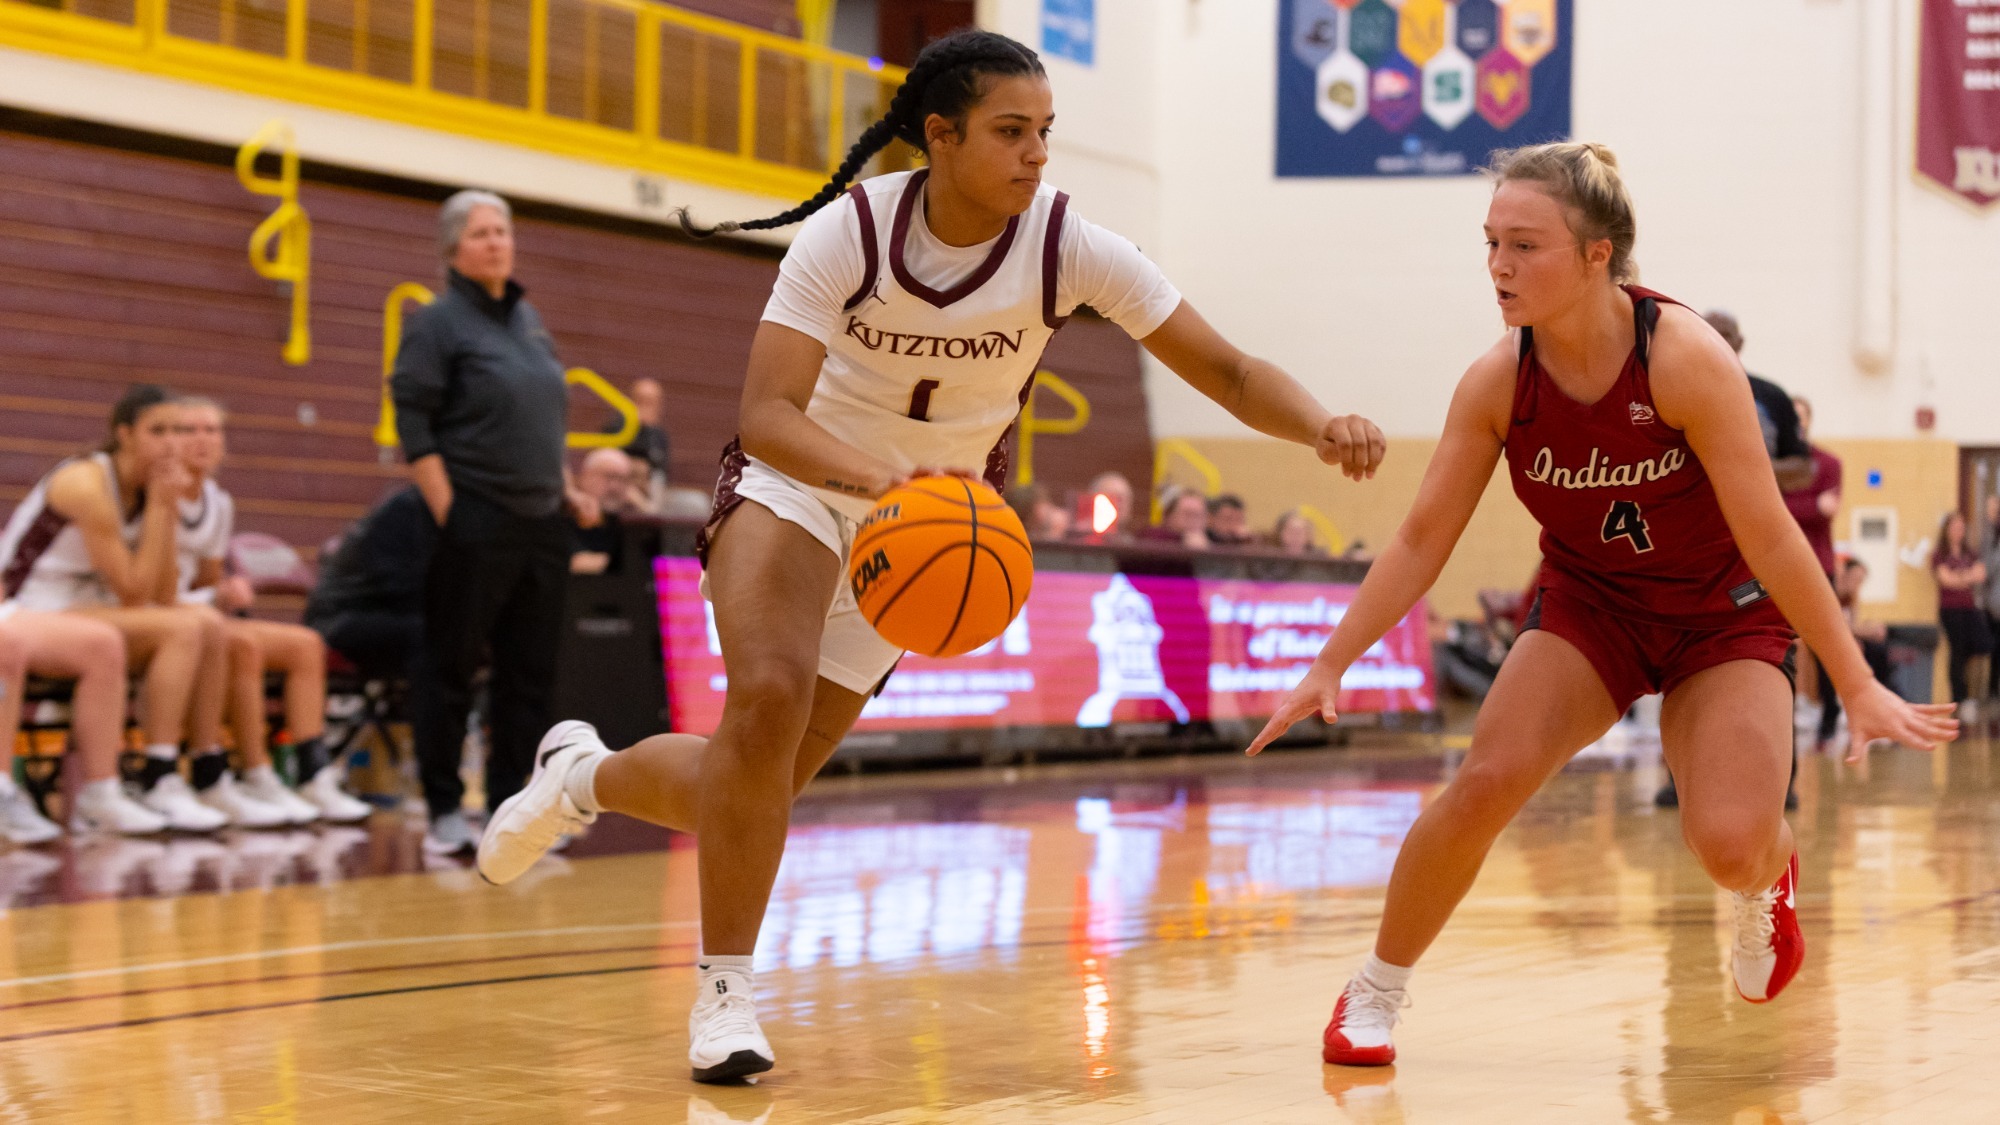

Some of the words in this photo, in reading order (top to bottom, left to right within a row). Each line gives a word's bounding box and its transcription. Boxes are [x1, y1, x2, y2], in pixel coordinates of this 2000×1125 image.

[844, 315, 1028, 360] KUTZTOWN
[907, 377, 942, 422] 1
[1525, 446, 1686, 490] Indiana
[1600, 500, 1655, 554] 4
